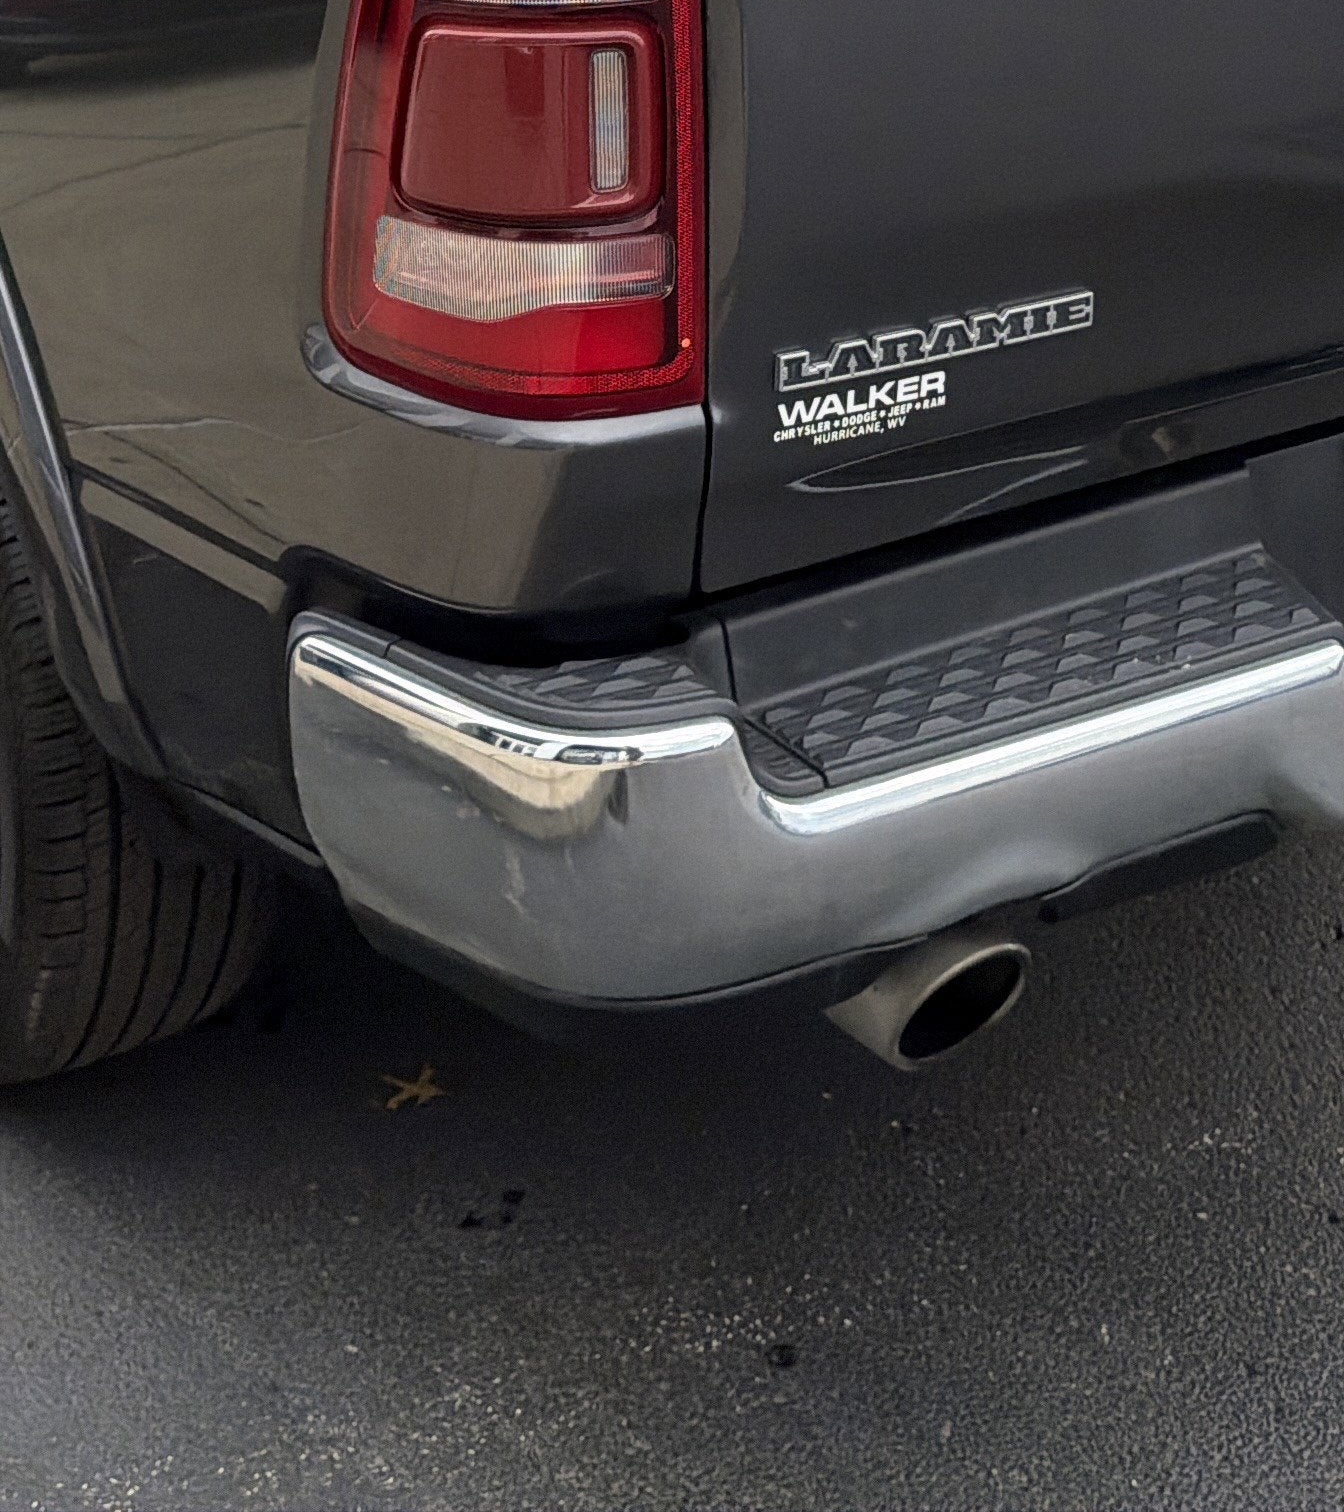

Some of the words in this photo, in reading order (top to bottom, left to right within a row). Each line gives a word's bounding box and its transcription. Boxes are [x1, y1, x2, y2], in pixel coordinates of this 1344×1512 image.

[777, 290, 1093, 392] LARAMIE
[773, 420, 831, 442] CHRYSLER
[842, 410, 877, 428] DODGE
[888, 402, 913, 417] JEEP
[922, 395, 947, 409] RAM
[778, 371, 946, 427] WALKER
[813, 423, 885, 446] HURRICANE,
[887, 416, 907, 429] WV
